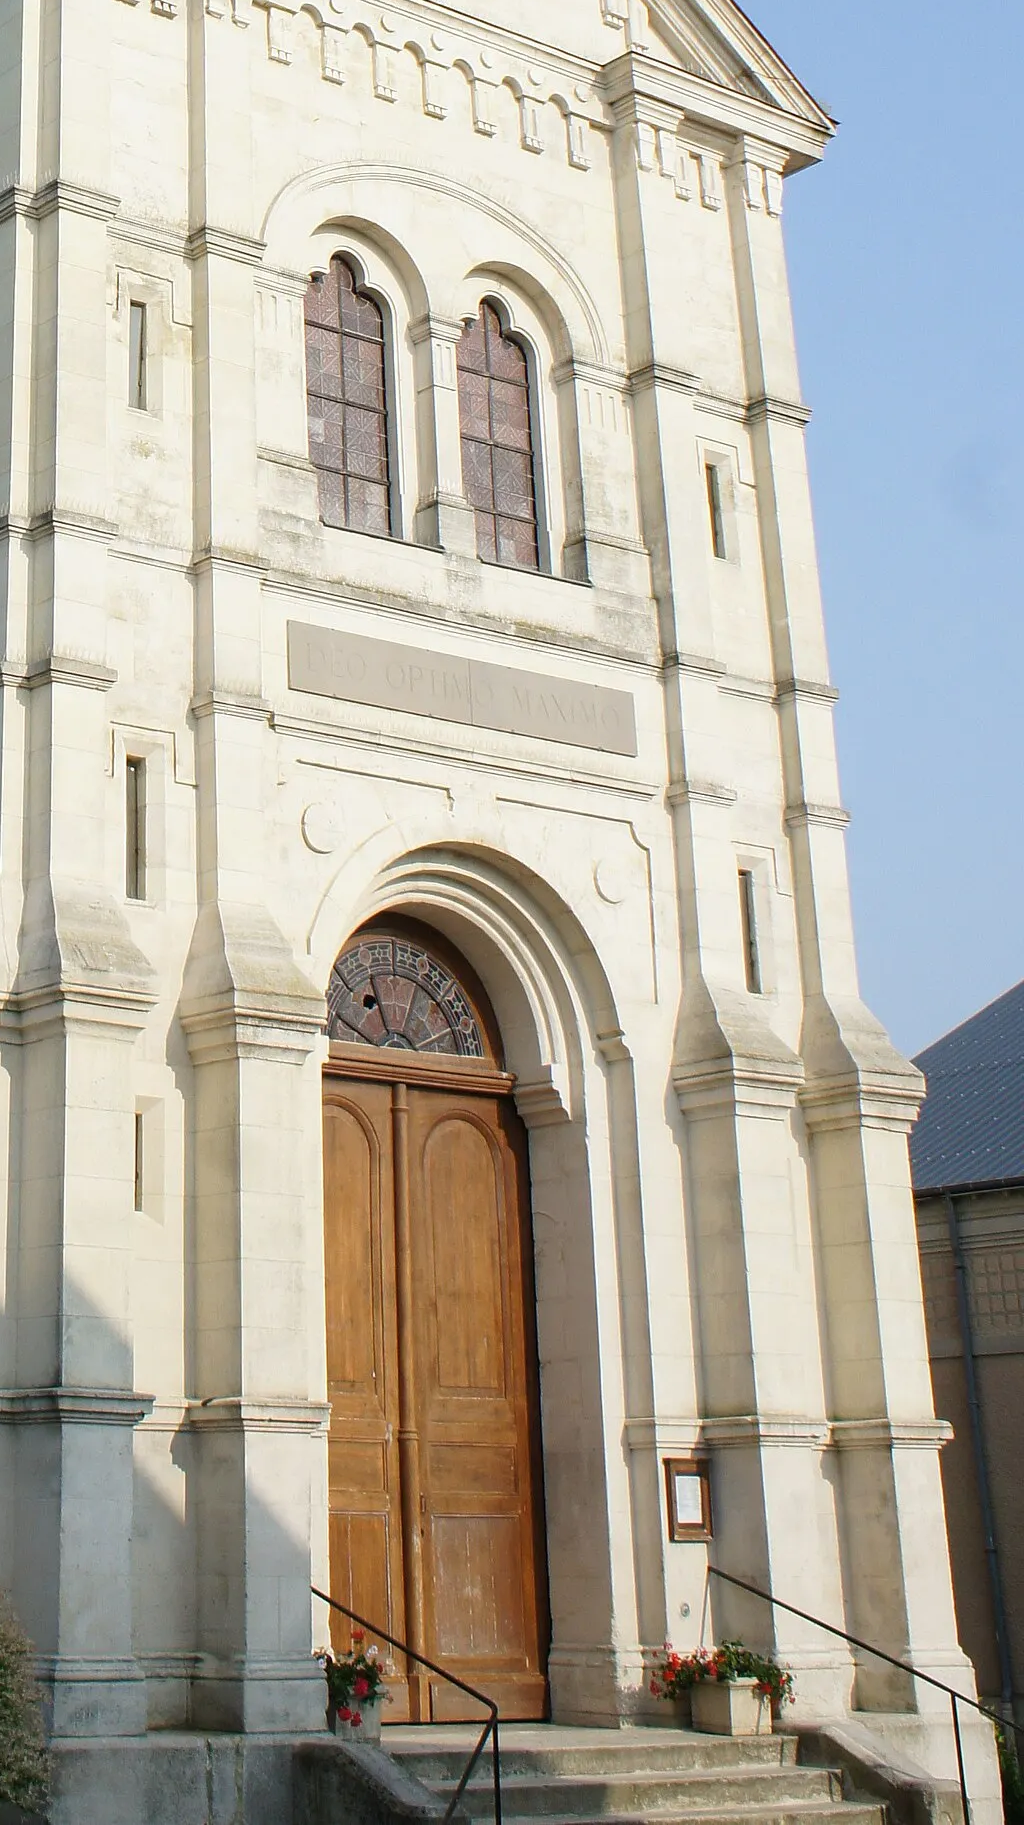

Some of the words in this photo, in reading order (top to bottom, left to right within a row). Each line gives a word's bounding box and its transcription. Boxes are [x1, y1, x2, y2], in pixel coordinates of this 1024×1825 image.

[305, 641, 367, 680] DEO
[384, 660, 495, 707] OPTIMO
[511, 685, 621, 731] MAXIMO
